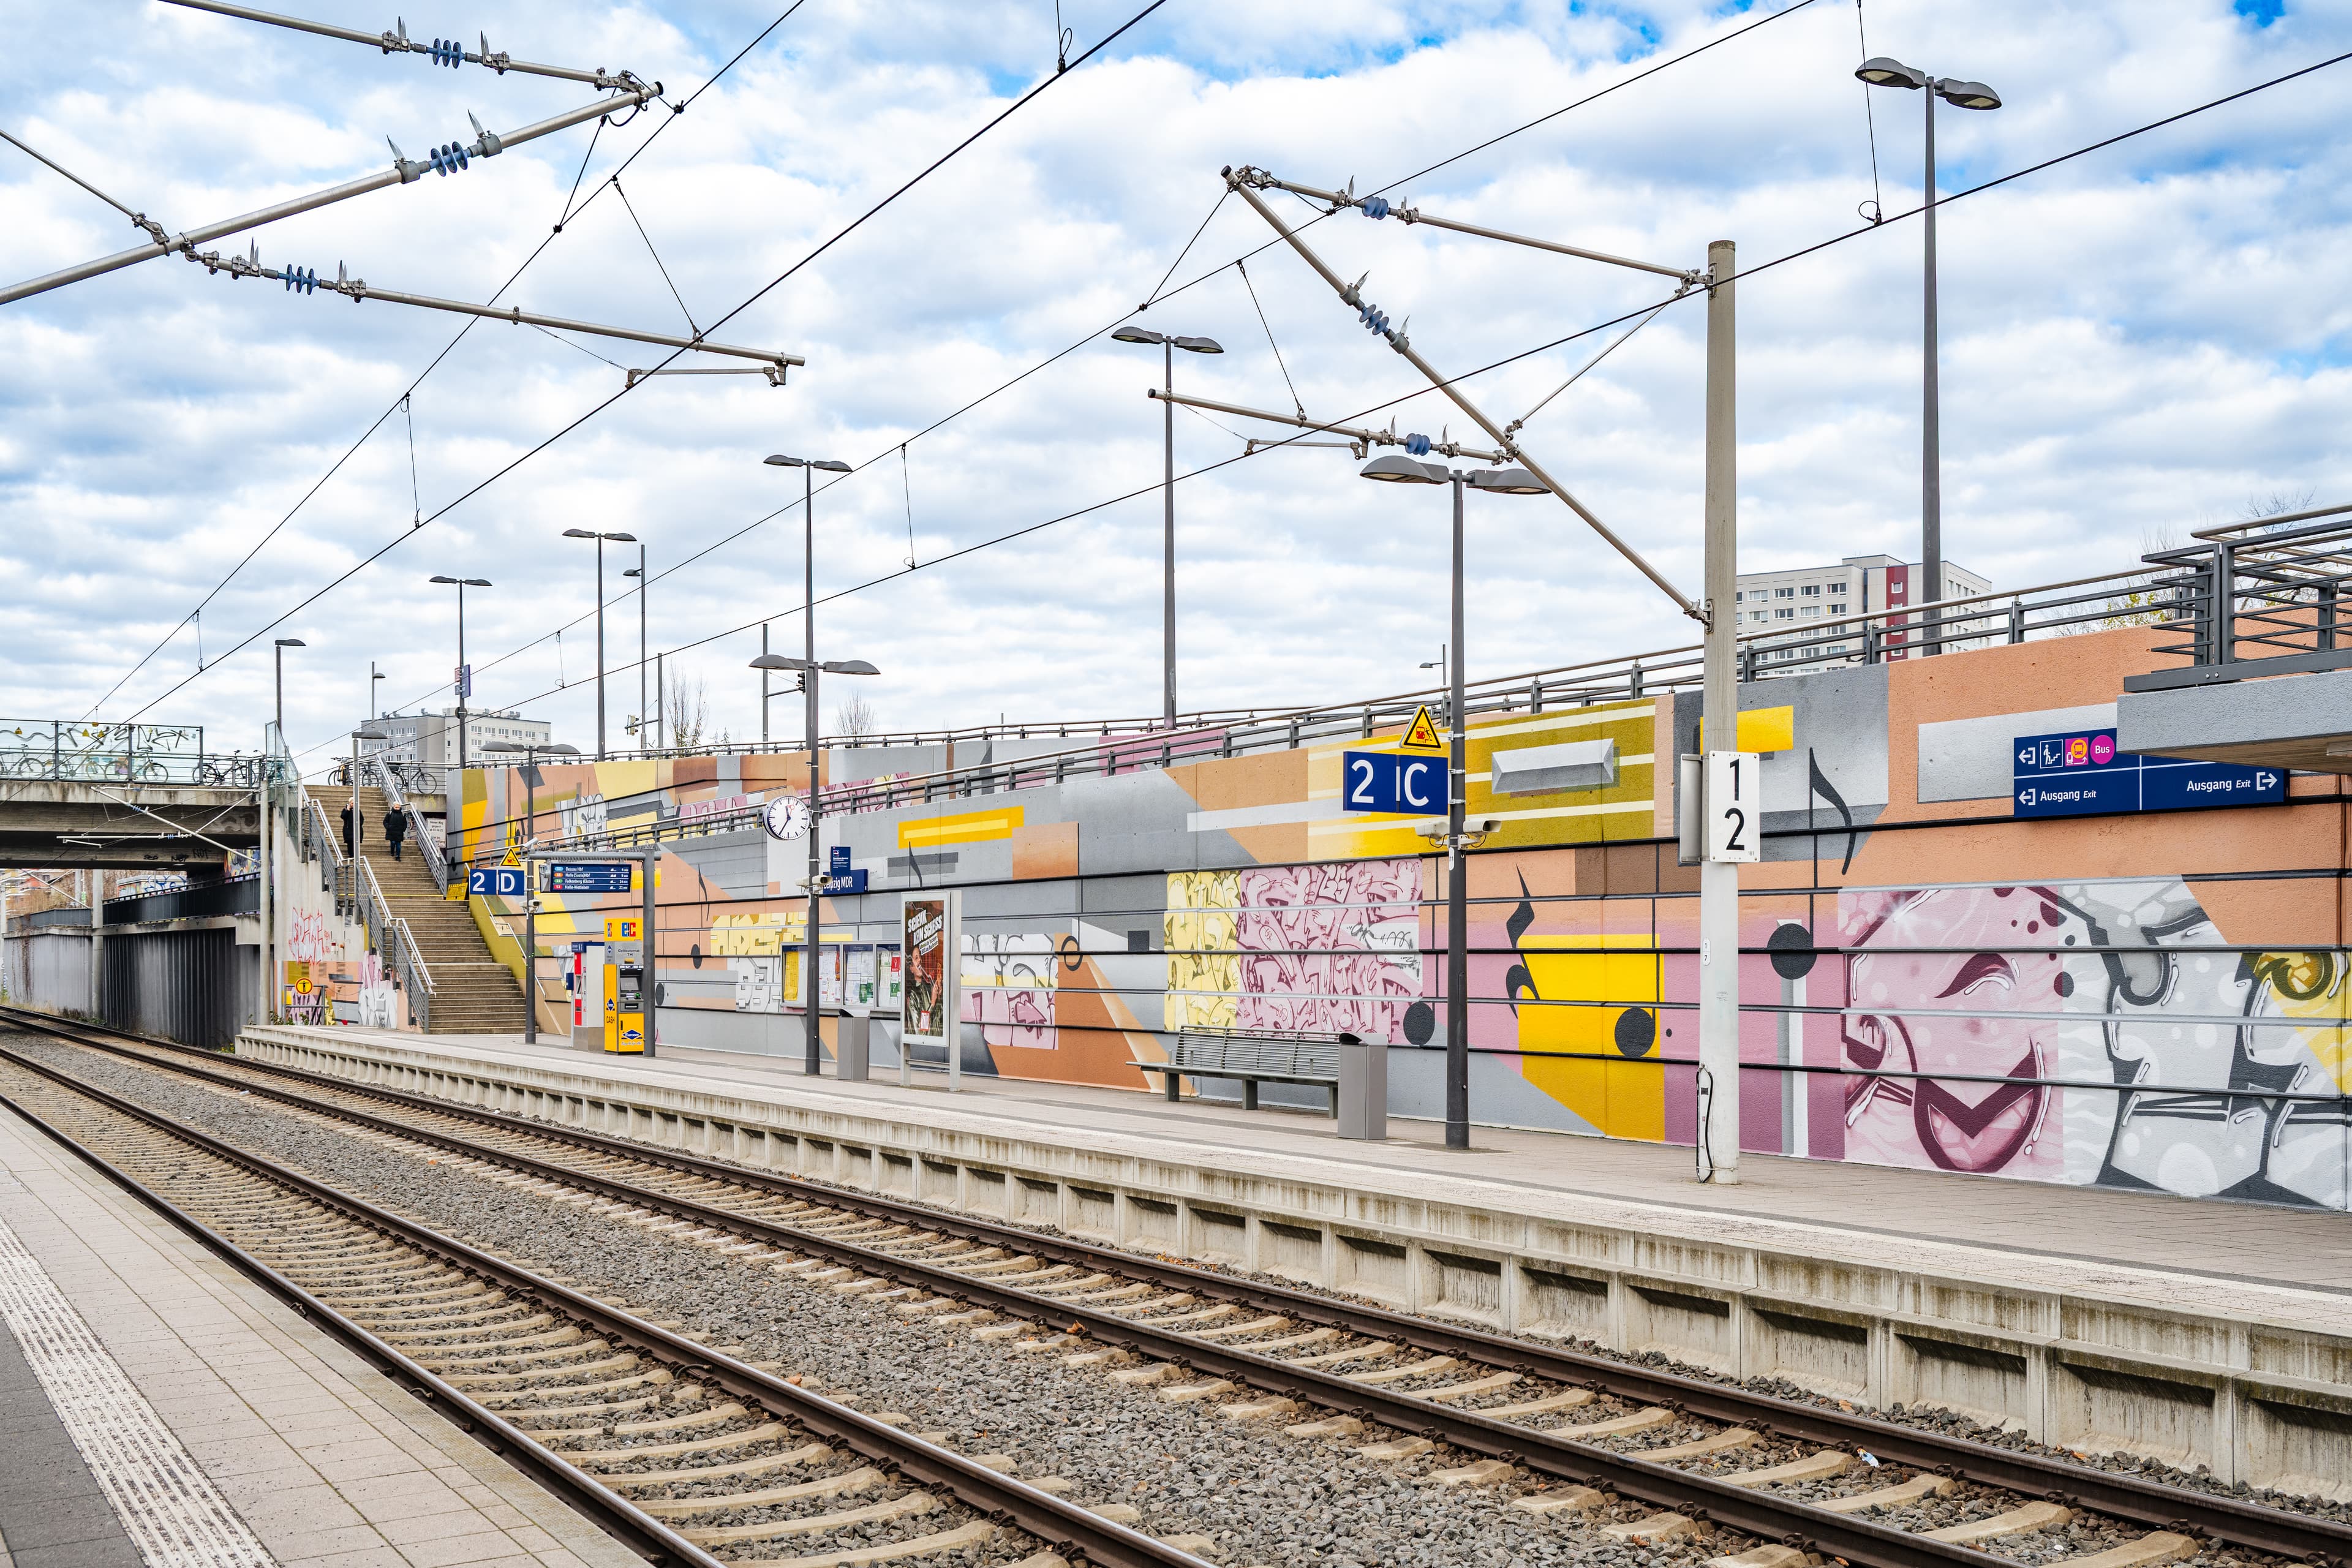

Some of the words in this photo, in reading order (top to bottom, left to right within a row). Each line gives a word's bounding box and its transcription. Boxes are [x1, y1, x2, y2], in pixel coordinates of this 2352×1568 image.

[2095, 745, 2110, 754] Bus
[1351, 760, 1374, 804] 2
[1404, 763, 1429, 807] C
[1730, 759, 1740, 801] 1
[2187, 780, 2232, 793] Ausgang
[2236, 780, 2251, 788] Exit
[2040, 791, 2080, 802] Ausgang
[2083, 790, 2097, 799] Exit
[1724, 807, 1745, 851] 2
[472, 872, 485, 892] 2
[500, 873, 515, 892] D
[841, 876, 853, 888] MDR
[908, 910, 927, 933] SCHENK
[913, 926, 924, 946] KEIN
[924, 914, 942, 940] SCHEISS
[606, 1016, 615, 1024] CASH
